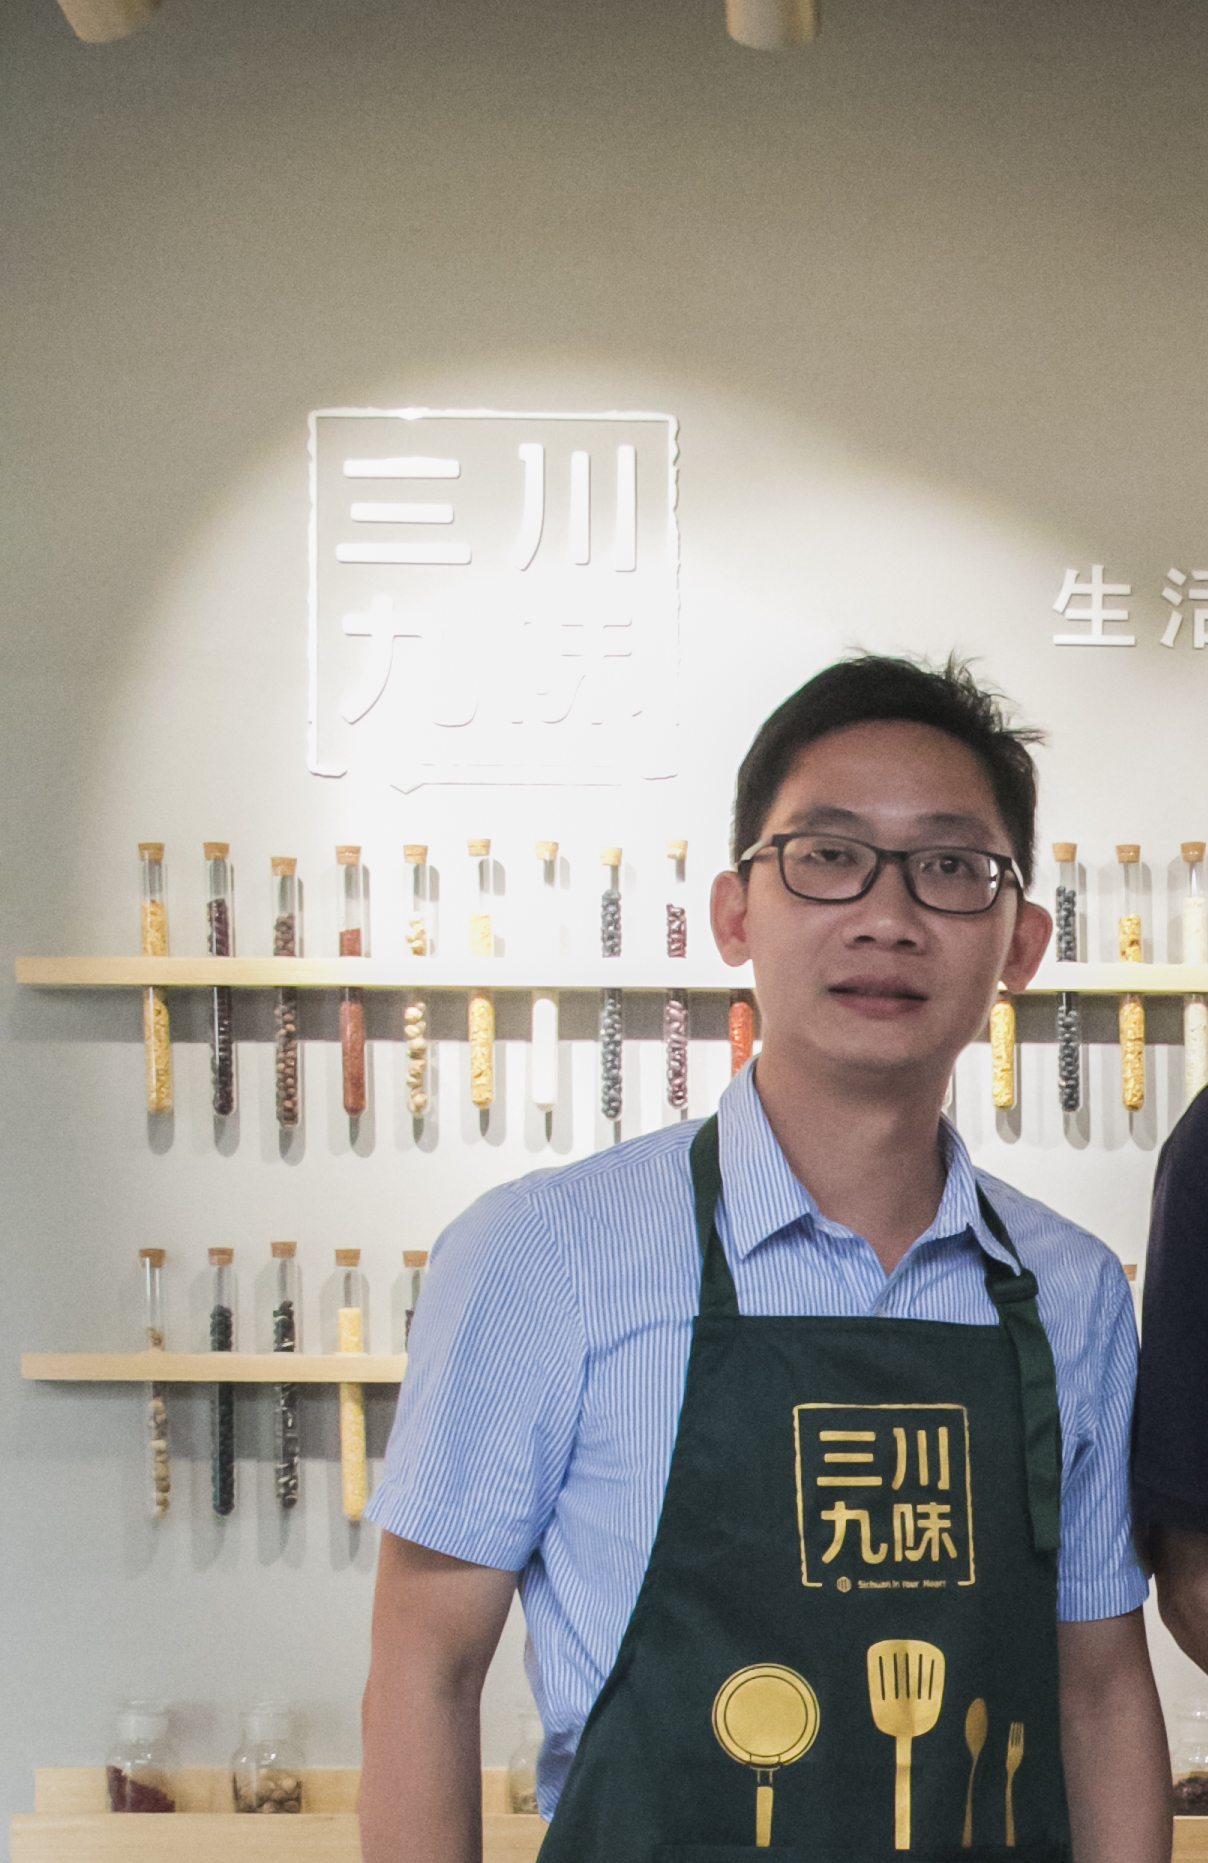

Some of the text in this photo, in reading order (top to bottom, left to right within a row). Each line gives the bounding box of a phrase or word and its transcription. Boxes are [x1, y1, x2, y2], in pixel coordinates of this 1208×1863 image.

[336, 442, 637, 573] 三川
[816, 1426, 950, 1490] 三川
[820, 1501, 958, 1564] 九味
